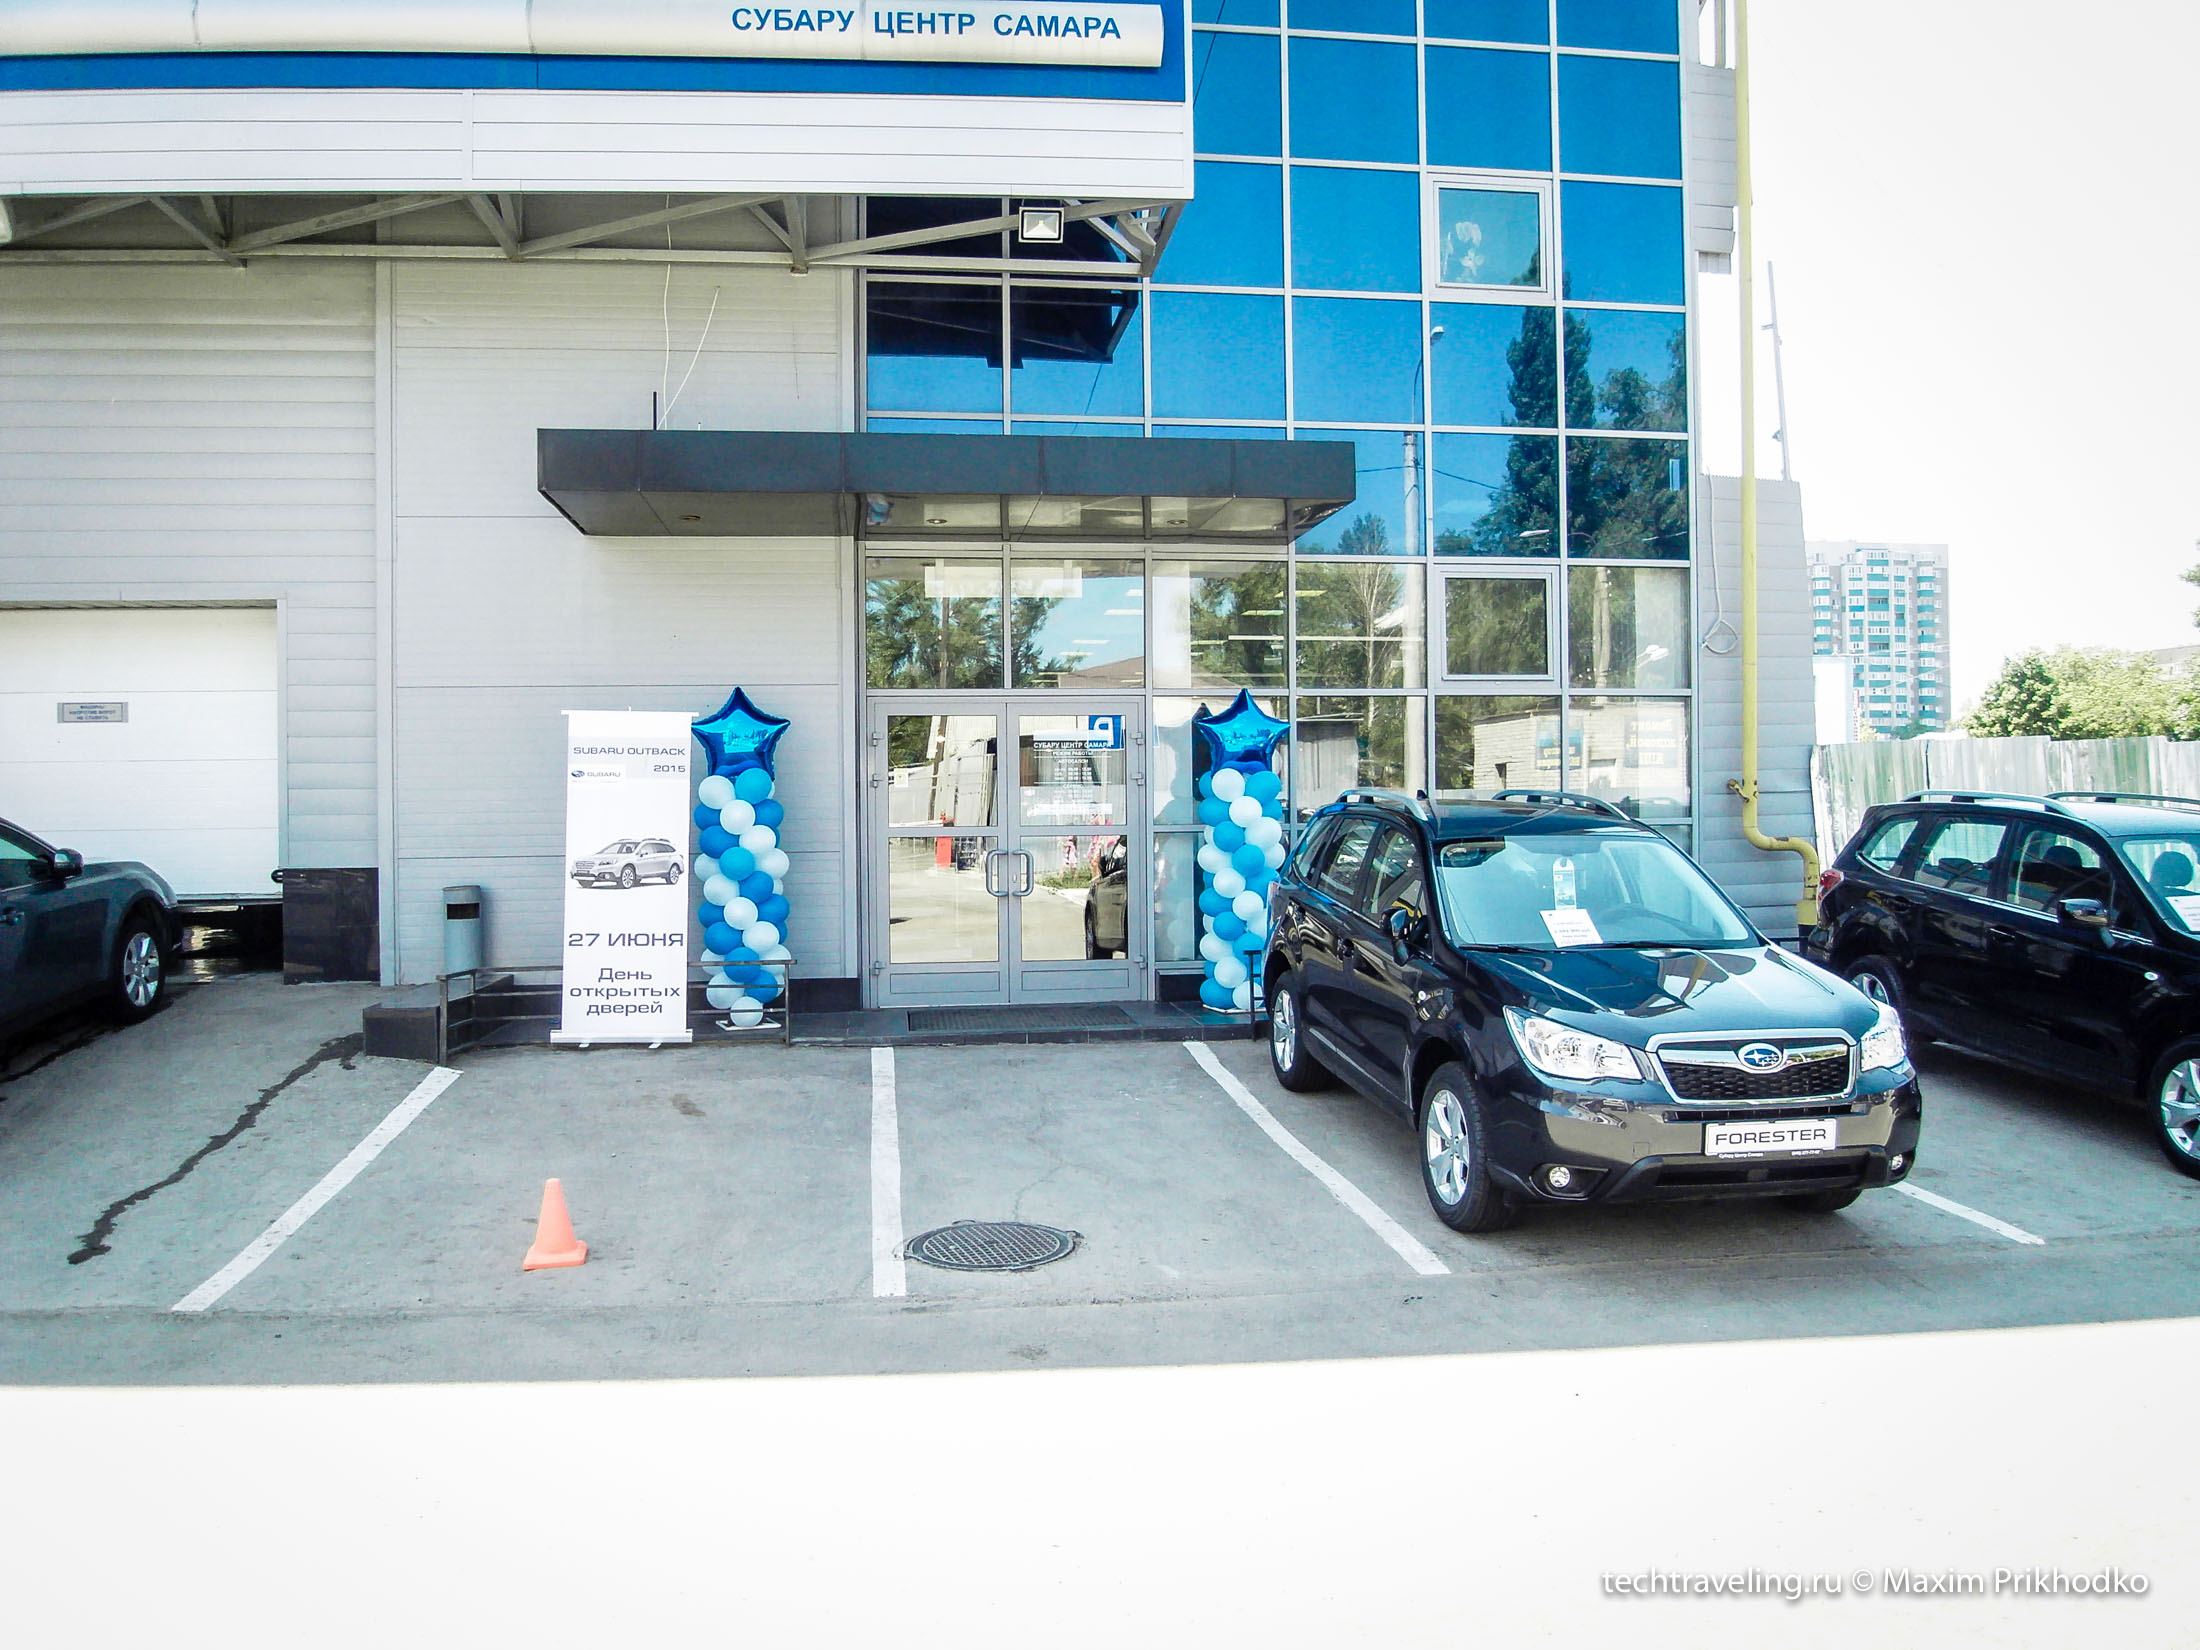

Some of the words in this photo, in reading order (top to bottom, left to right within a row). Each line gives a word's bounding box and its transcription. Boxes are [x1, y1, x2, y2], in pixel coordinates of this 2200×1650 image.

[732, 8, 854, 33] СУБАРУ
[874, 12, 976, 38] ЦЕНТР
[993, 14, 1122, 39] САМАРА
[573, 747, 624, 755] SUBARU
[627, 747, 686, 756] OUTBACK
[1033, 741, 1060, 749] СУБАРУ
[1061, 741, 1083, 749] ЦЕНТР
[653, 764, 686, 773] 2015
[568, 933, 601, 947] 27
[608, 933, 684, 947] ИЮНЯ
[597, 968, 652, 982] День
[570, 988, 681, 1000] открытых
[587, 1001, 663, 1016] дверей
[1715, 1128, 1827, 1145] FORESTER
